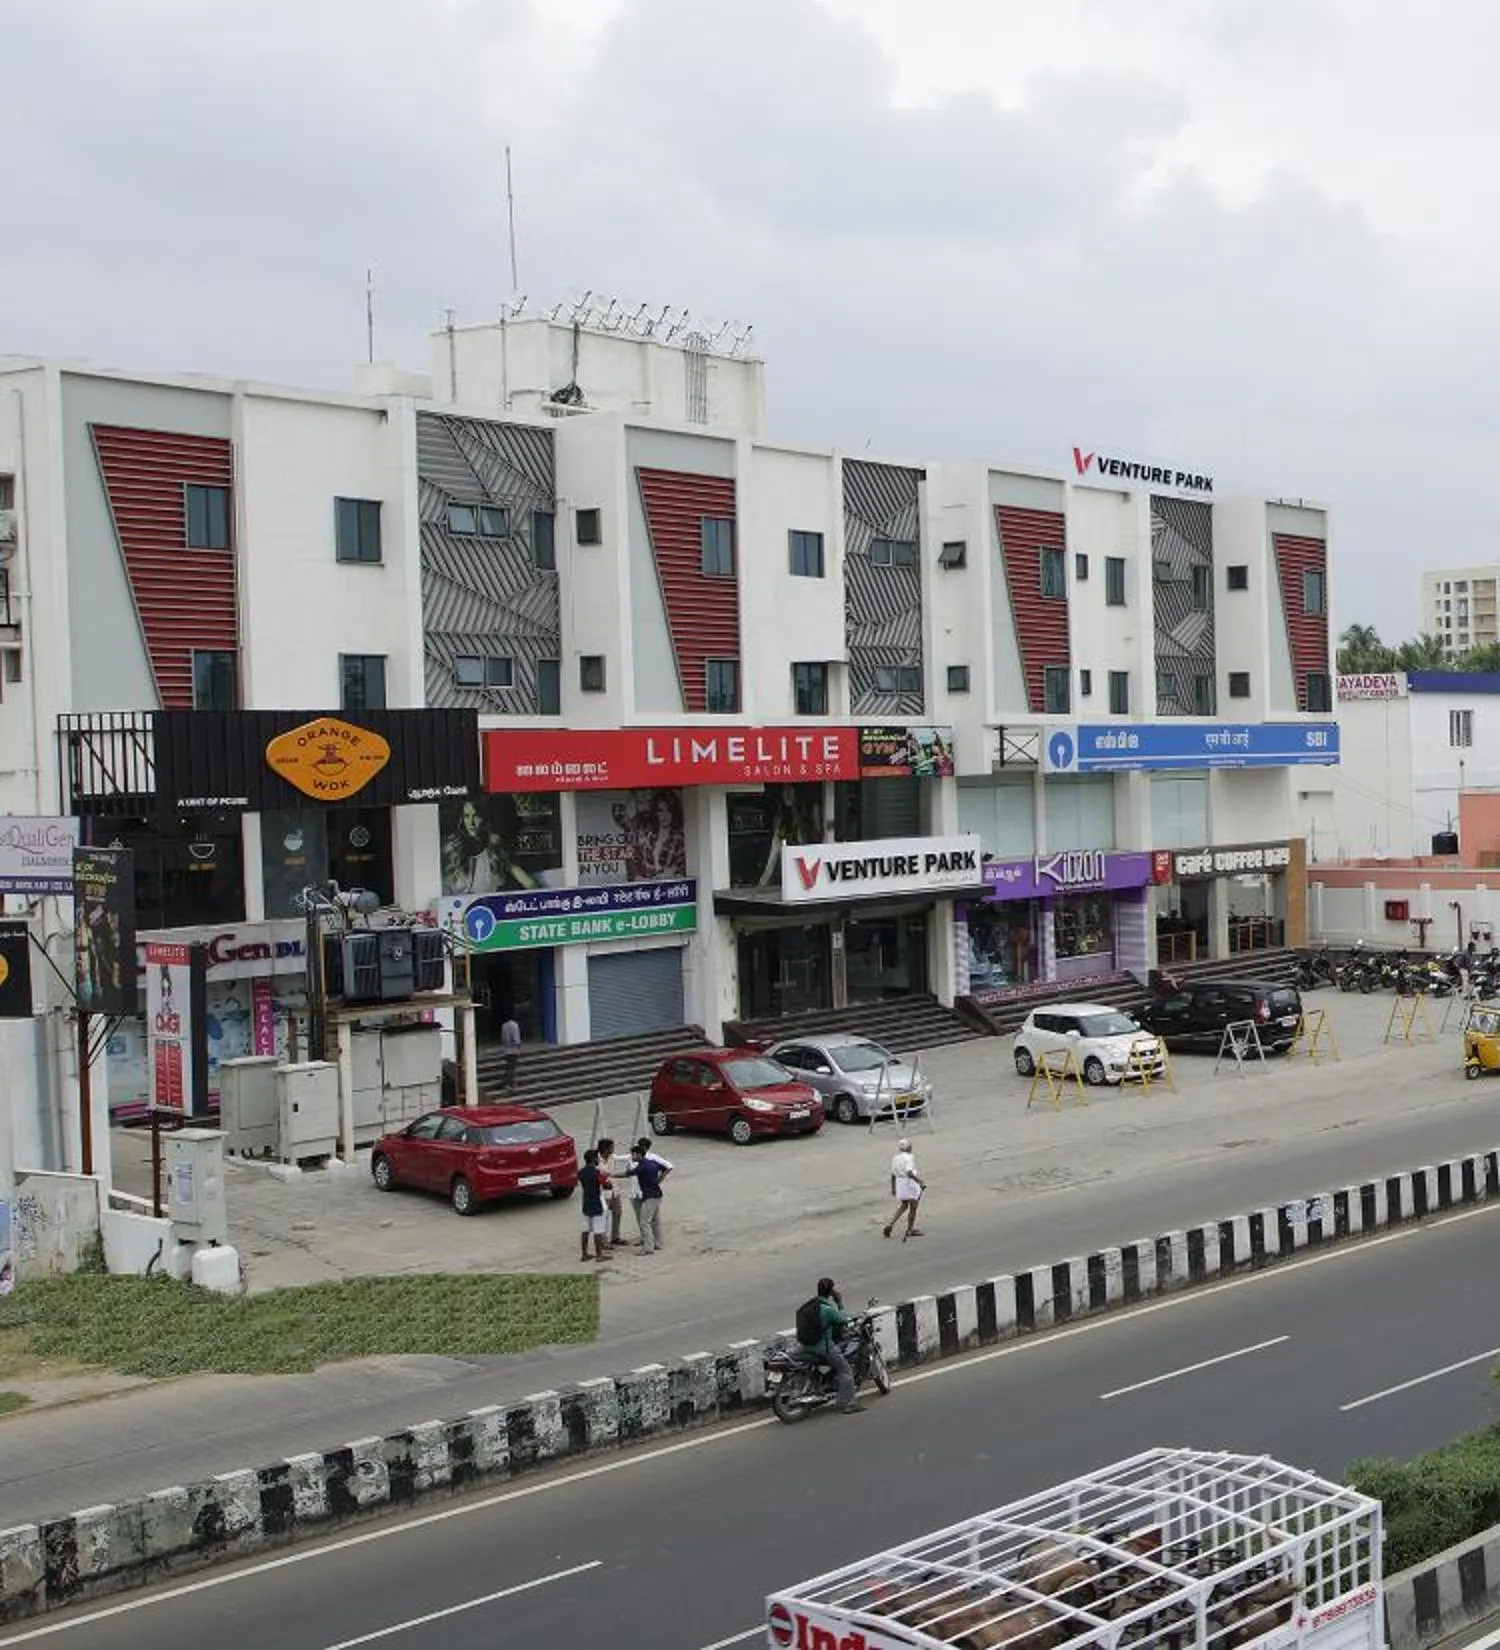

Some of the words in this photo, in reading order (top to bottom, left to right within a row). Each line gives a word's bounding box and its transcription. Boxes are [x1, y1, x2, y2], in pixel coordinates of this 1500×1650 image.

[1097, 456, 1172, 485] VENTURE
[1175, 470, 1213, 492] PARK
[297, 727, 362, 747] ORANGE
[1305, 731, 1327, 747] SBI
[646, 735, 839, 764] LIMELITE
[743, 764, 791, 777] SALON
[815, 762, 841, 775] SPA
[313, 779, 350, 791] WOK
[577, 833, 614, 847] BRING
[615, 832, 640, 846] OUT
[578, 848, 603, 863] THE
[603, 847, 635, 861] STAR
[579, 863, 594, 874] IN
[594, 862, 620, 874] YOU
[826, 855, 919, 883] VENTURE
[924, 849, 977, 873] PARK
[519, 923, 565, 941] STATE
[571, 919, 611, 937] BANK
[616, 911, 676, 931] e-LOBBY
